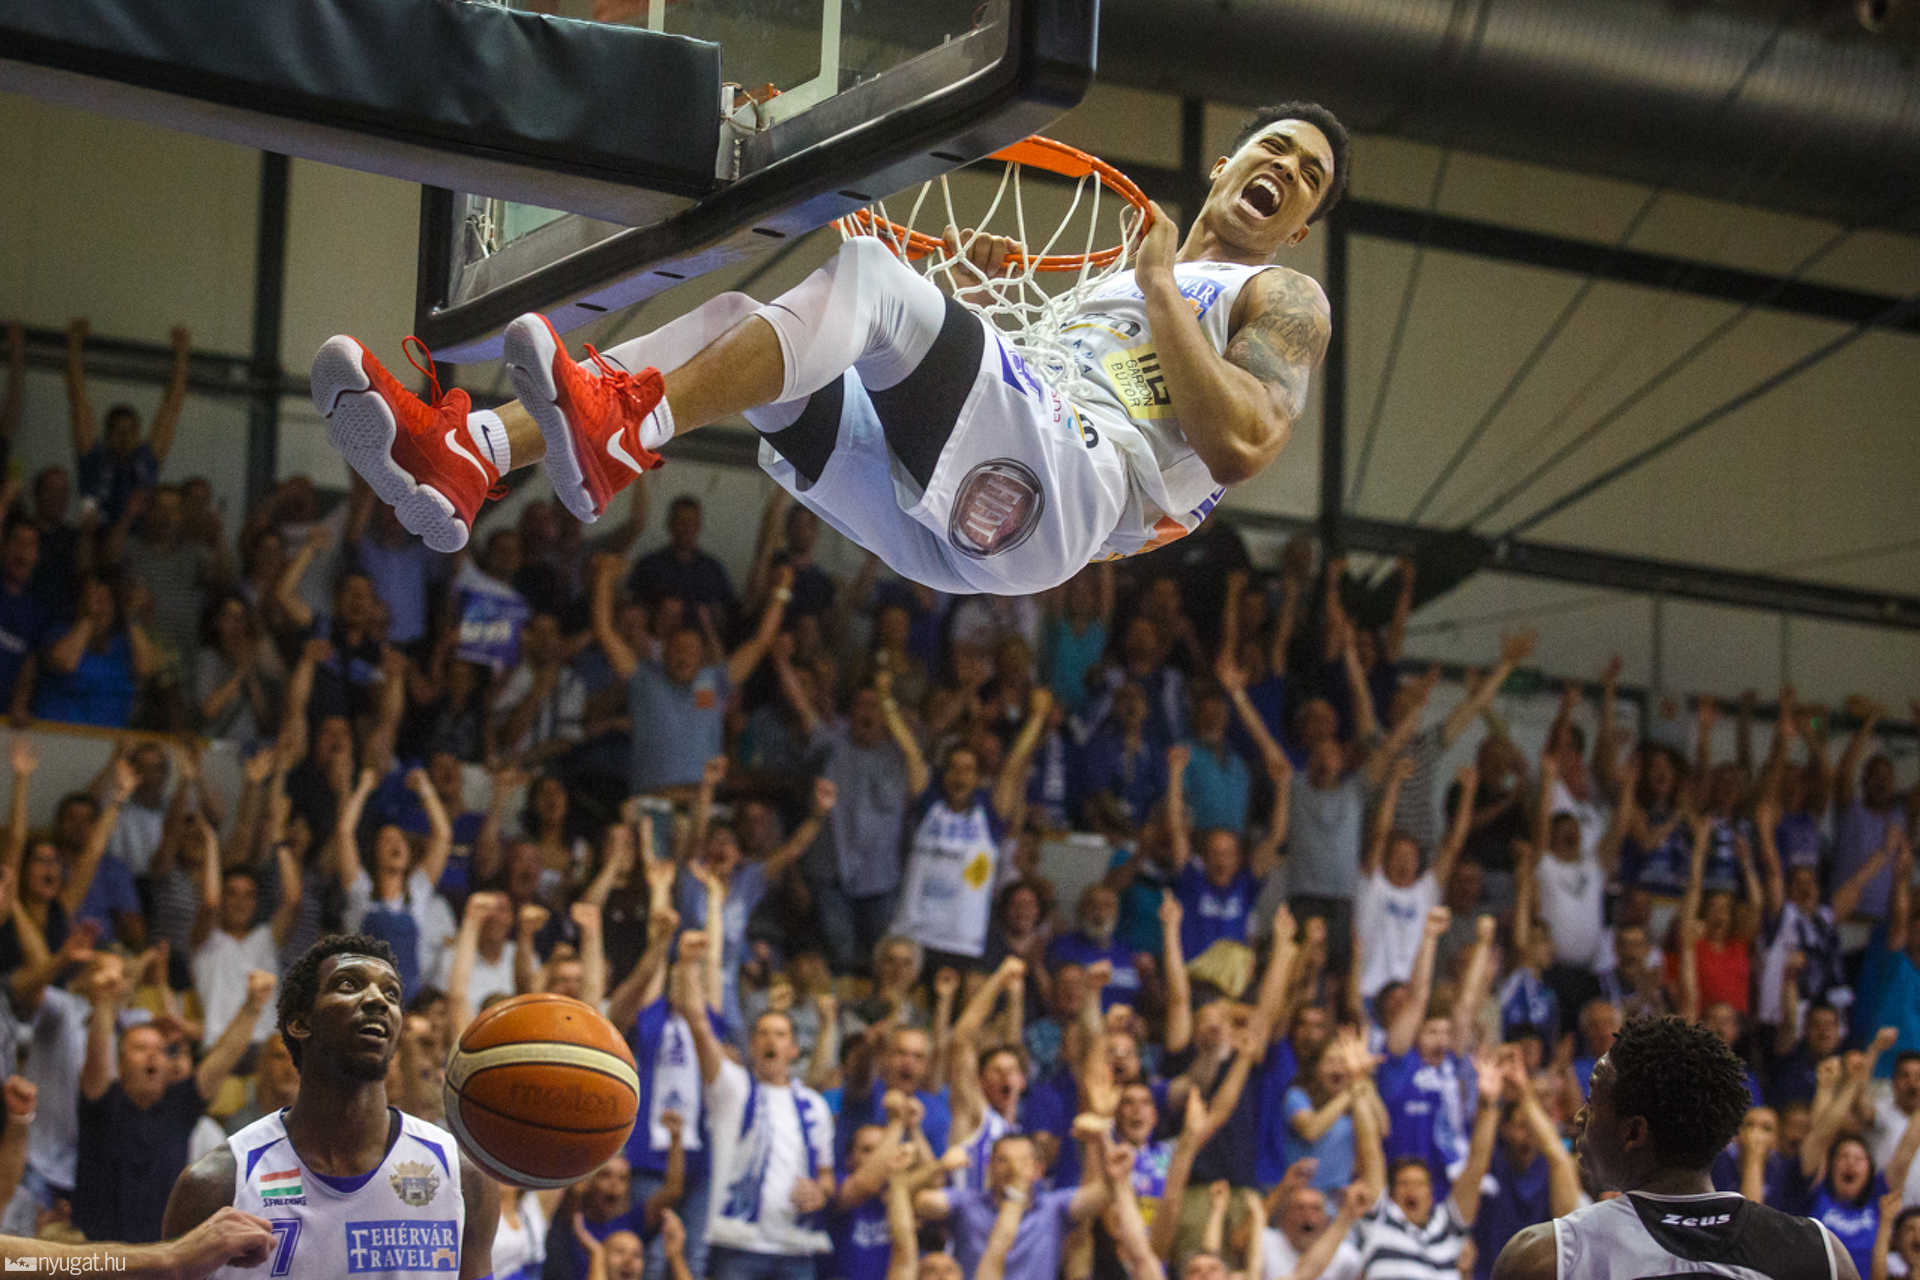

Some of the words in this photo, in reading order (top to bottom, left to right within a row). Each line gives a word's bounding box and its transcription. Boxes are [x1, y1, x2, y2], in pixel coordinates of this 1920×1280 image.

[270, 1218, 303, 1278] 7
[351, 1221, 455, 1250] FEHÉRVÁR
[350, 1248, 431, 1269] TRAVEL
